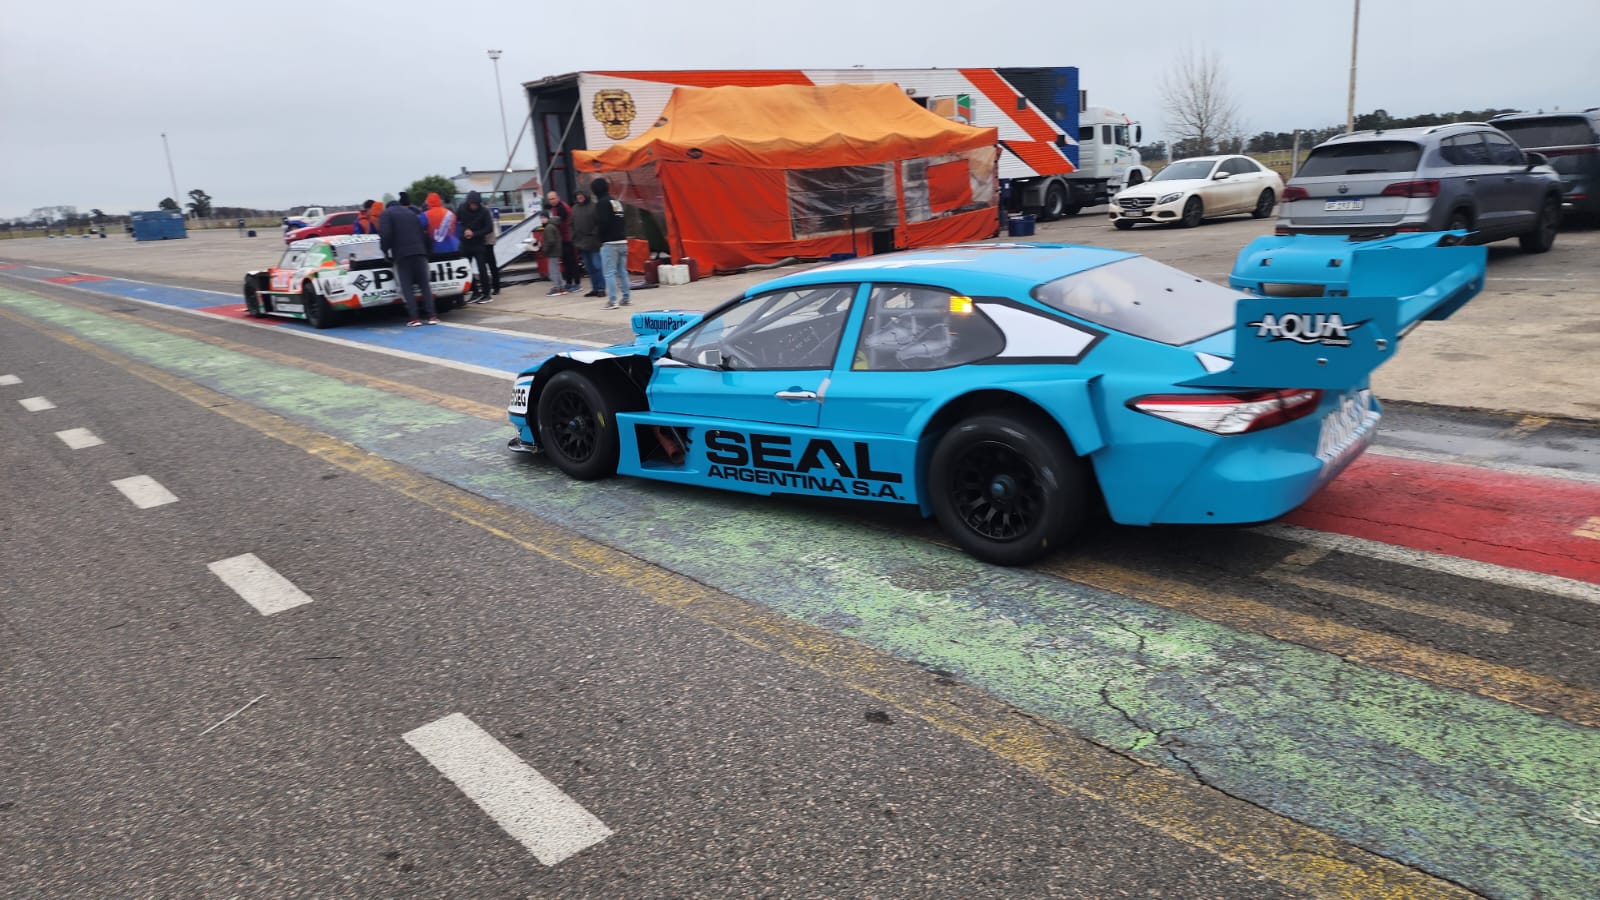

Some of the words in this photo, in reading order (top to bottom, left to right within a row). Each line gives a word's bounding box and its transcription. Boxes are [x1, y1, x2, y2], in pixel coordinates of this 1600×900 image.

[373, 262, 468, 289] Plis
[1256, 312, 1348, 338] AQUA
[705, 429, 903, 483] SEAL
[708, 465, 847, 494] ARGENTINA
[852, 481, 905, 500] S.A.
